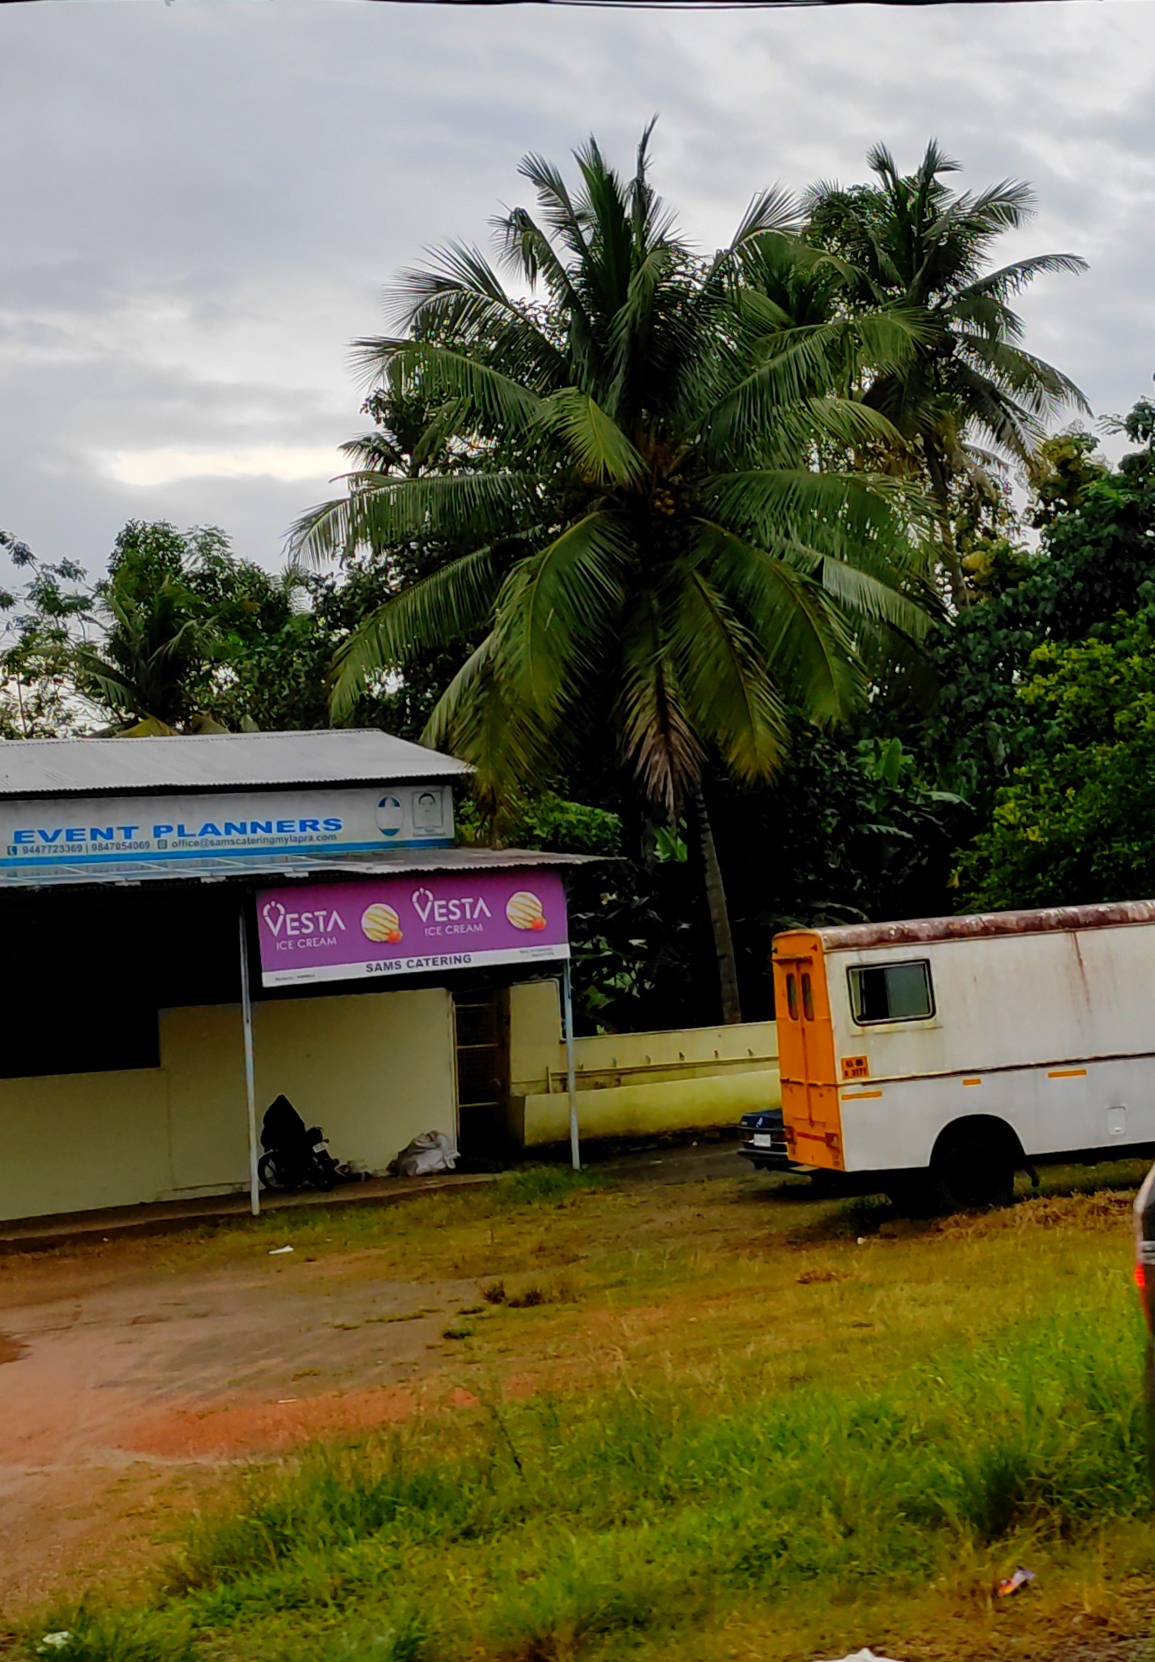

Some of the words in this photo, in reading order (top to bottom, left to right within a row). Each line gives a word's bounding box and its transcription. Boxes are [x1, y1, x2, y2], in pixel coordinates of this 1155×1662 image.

[13, 826, 140, 844] EVENT
[152, 817, 343, 838] PLANNERS
[412, 887, 493, 923] VESTA
[262, 901, 346, 937] VESTA
[424, 926, 442, 937] ICE
[445, 923, 484, 934] CREAM
[276, 940, 294, 951] ICE
[297, 936, 338, 949] CREAM
[365, 960, 402, 974] SAMS
[406, 954, 472, 969] CATERING
